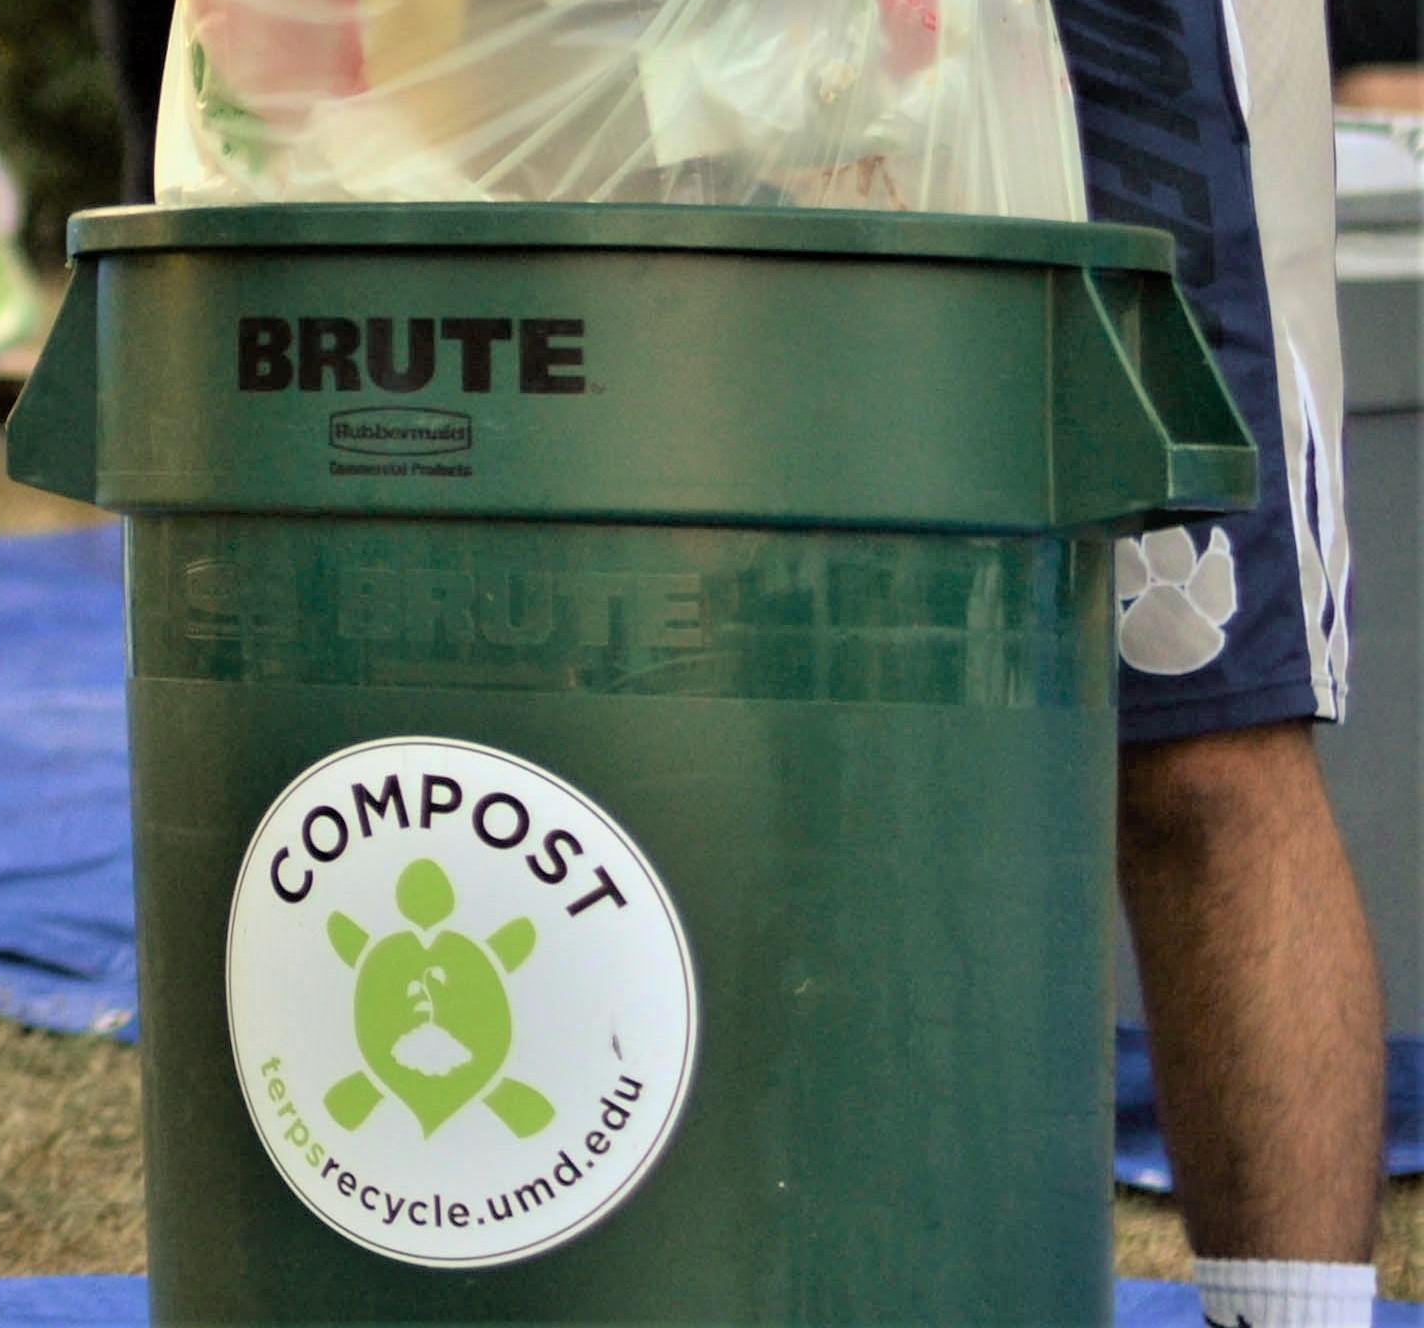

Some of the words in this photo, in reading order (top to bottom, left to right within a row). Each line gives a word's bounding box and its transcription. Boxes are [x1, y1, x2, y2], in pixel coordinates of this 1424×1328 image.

[237, 317, 587, 394] BRUTE
[335, 422, 466, 441] Rubbermaid
[269, 773, 629, 919] COMPOST
[259, 1055, 646, 1229] terpsrecycle.umd.edu
